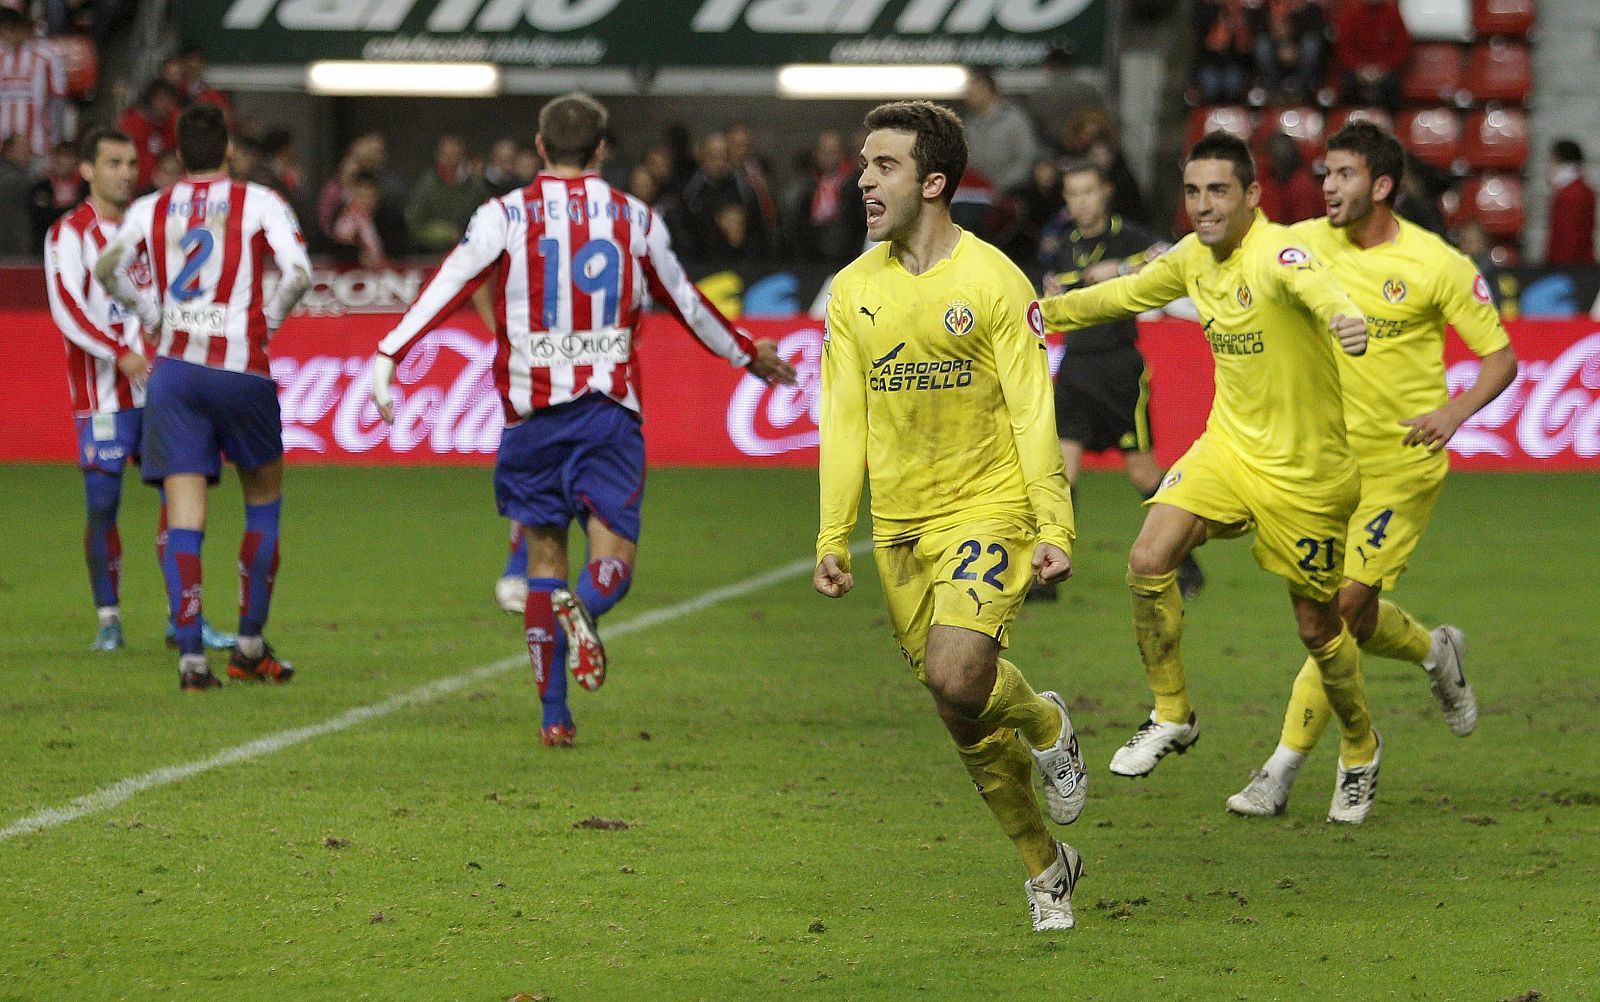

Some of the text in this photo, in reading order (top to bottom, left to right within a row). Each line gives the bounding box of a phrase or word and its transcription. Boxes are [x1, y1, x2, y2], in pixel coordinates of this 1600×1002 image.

[171, 229, 214, 301] 2
[538, 238, 620, 329] 19
[869, 371, 974, 393] CASTELLO
[880, 359, 974, 377] AEROPORT
[1364, 508, 1393, 549] 4
[951, 539, 1009, 592] 22
[1296, 536, 1336, 572] 21
